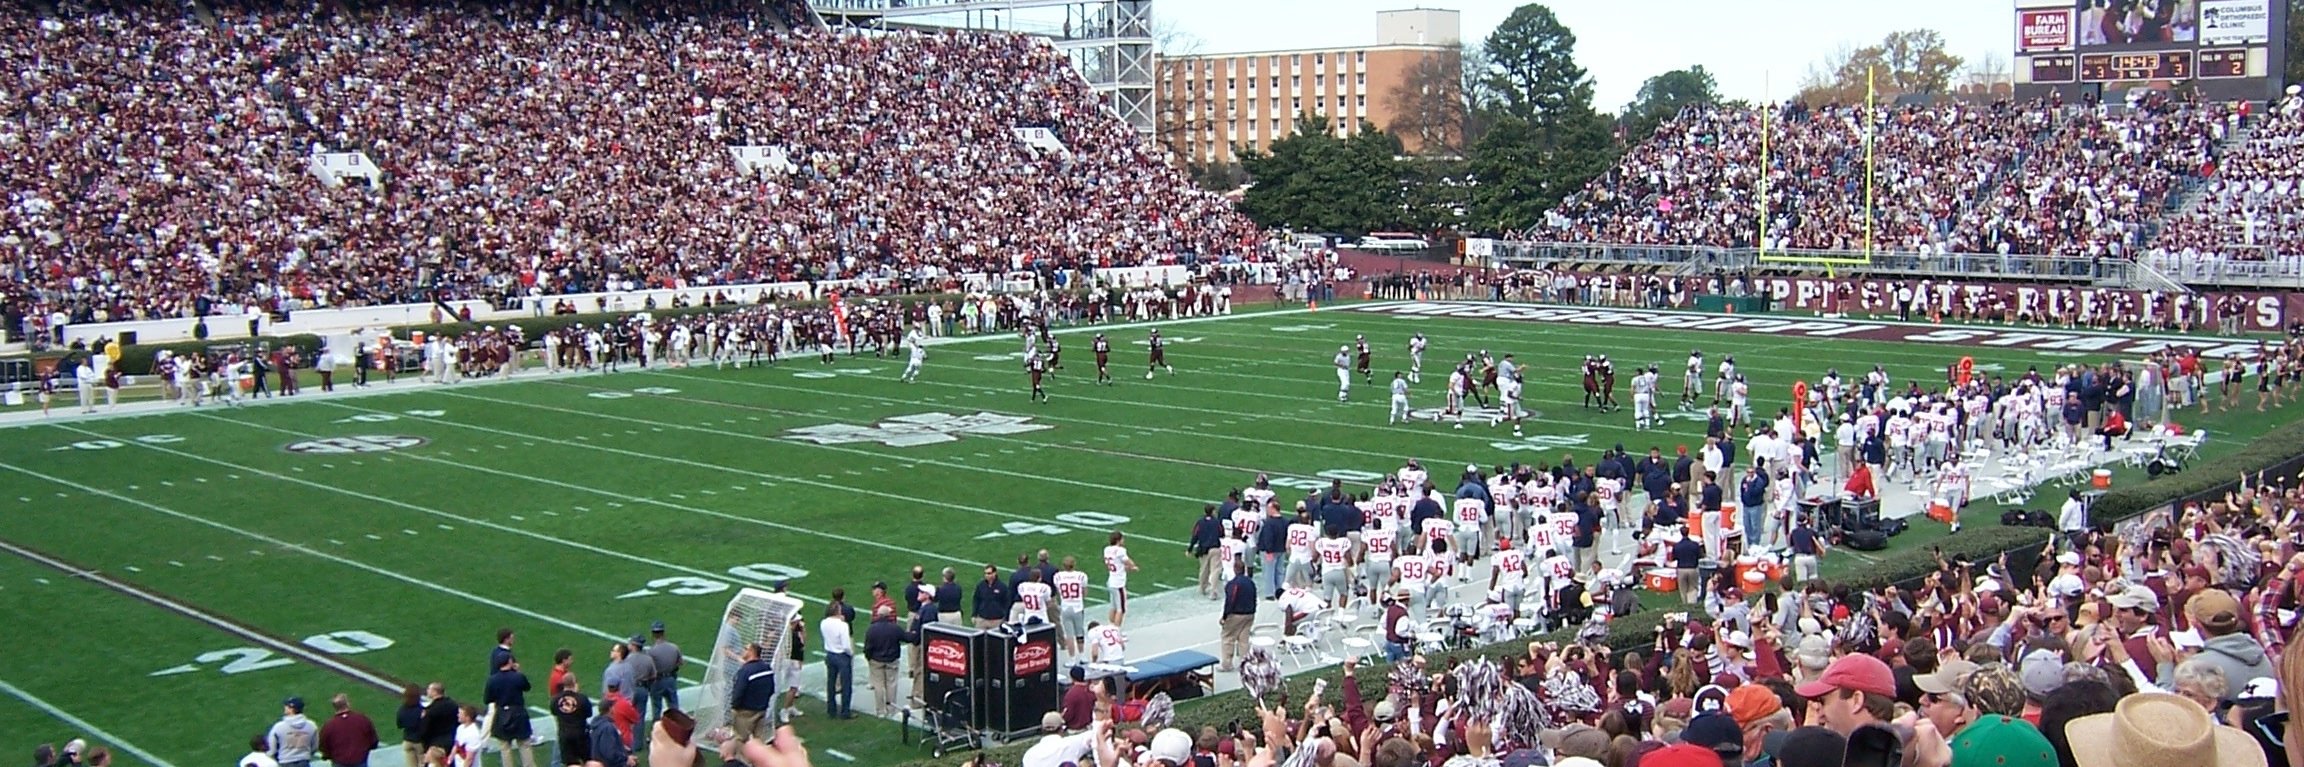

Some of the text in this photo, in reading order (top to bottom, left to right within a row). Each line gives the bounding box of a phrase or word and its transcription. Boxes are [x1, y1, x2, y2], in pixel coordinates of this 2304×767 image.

[2220, 5, 2262, 13] COLUMBUS
[2035, 14, 2065, 25] FARM
[2024, 25, 2066, 36] BUREAU
[2096, 66, 2105, 78] 3
[2174, 64, 2183, 76] 3
[2232, 62, 2241, 74] 2
[1932, 420, 1945, 433] 73
[1493, 492, 1508, 506] 51
[1375, 501, 1393, 517] 92
[1460, 506, 1477, 521] 48
[1001, 511, 1131, 536] 40
[1237, 519, 1256, 535] 40
[1555, 519, 1573, 536] 35
[1290, 529, 1307, 546] 82
[1369, 537, 1389, 553] 95
[1536, 530, 1552, 546] 41
[1323, 549, 1342, 563] 94
[1502, 554, 1520, 572] 42
[1403, 561, 1423, 579] 93
[1554, 561, 1570, 578] 49
[1757, 560, 1769, 572] G
[646, 563, 810, 597] 30
[1652, 576, 1661, 587] G
[1060, 582, 1080, 599] 89
[1023, 594, 1041, 611] 81
[194, 630, 396, 676] 20
